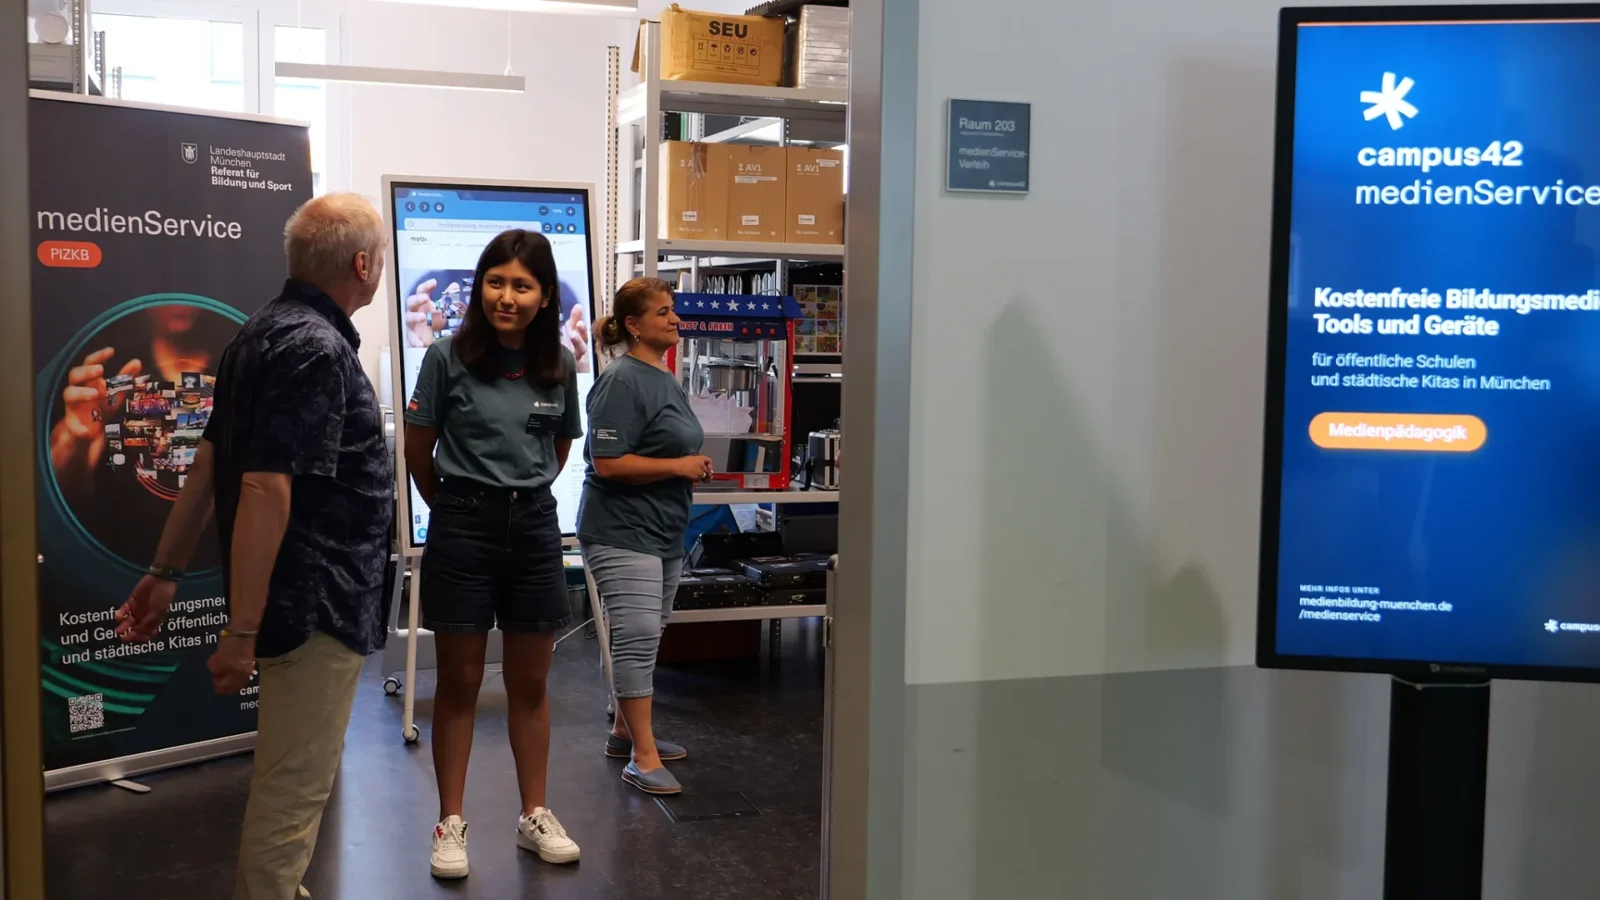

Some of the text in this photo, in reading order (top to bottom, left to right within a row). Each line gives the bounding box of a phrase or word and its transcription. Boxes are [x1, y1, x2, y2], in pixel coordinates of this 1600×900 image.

[708, 20, 748, 39] SEU
[959, 117, 1016, 132] Raum 203
[209, 145, 286, 162] Landeshauptstadt
[958, 146, 1028, 158] medienService-
[1357, 140, 1524, 173] campus42
[210, 155, 252, 168] München
[745, 163, 762, 172] AV1
[803, 163, 820, 173] AV1
[958, 159, 990, 169] Verleih
[211, 166, 260, 179] Referat für
[211, 176, 292, 192] Bildung und Sport
[1355, 179, 1600, 206] medienService
[37, 206, 242, 240] medienService
[50, 247, 90, 262] PIZKB
[1314, 287, 1600, 315] Kostenfreie Bildungsmedi
[679, 320, 699, 331] HOT
[699, 321, 707, 331] &
[707, 321, 734, 332] FRESH
[1312, 313, 1500, 336] Tools und Geräte
[1311, 352, 1477, 370] für öffentliche Schulen
[1311, 373, 1551, 391] und städtische Kitas in München
[1328, 422, 1468, 443] Medienpädagogik
[1299, 584, 1381, 595] MEHR INFOS UNTER
[1299, 596, 1453, 612] medienbildung-muenchen.de
[1298, 609, 1382, 622] /medienservice
[60, 629, 89, 645] und
[167, 611, 229, 631] öffentlich
[1559, 621, 1600, 634] campus
[62, 631, 217, 665] und städtische Kitas in
